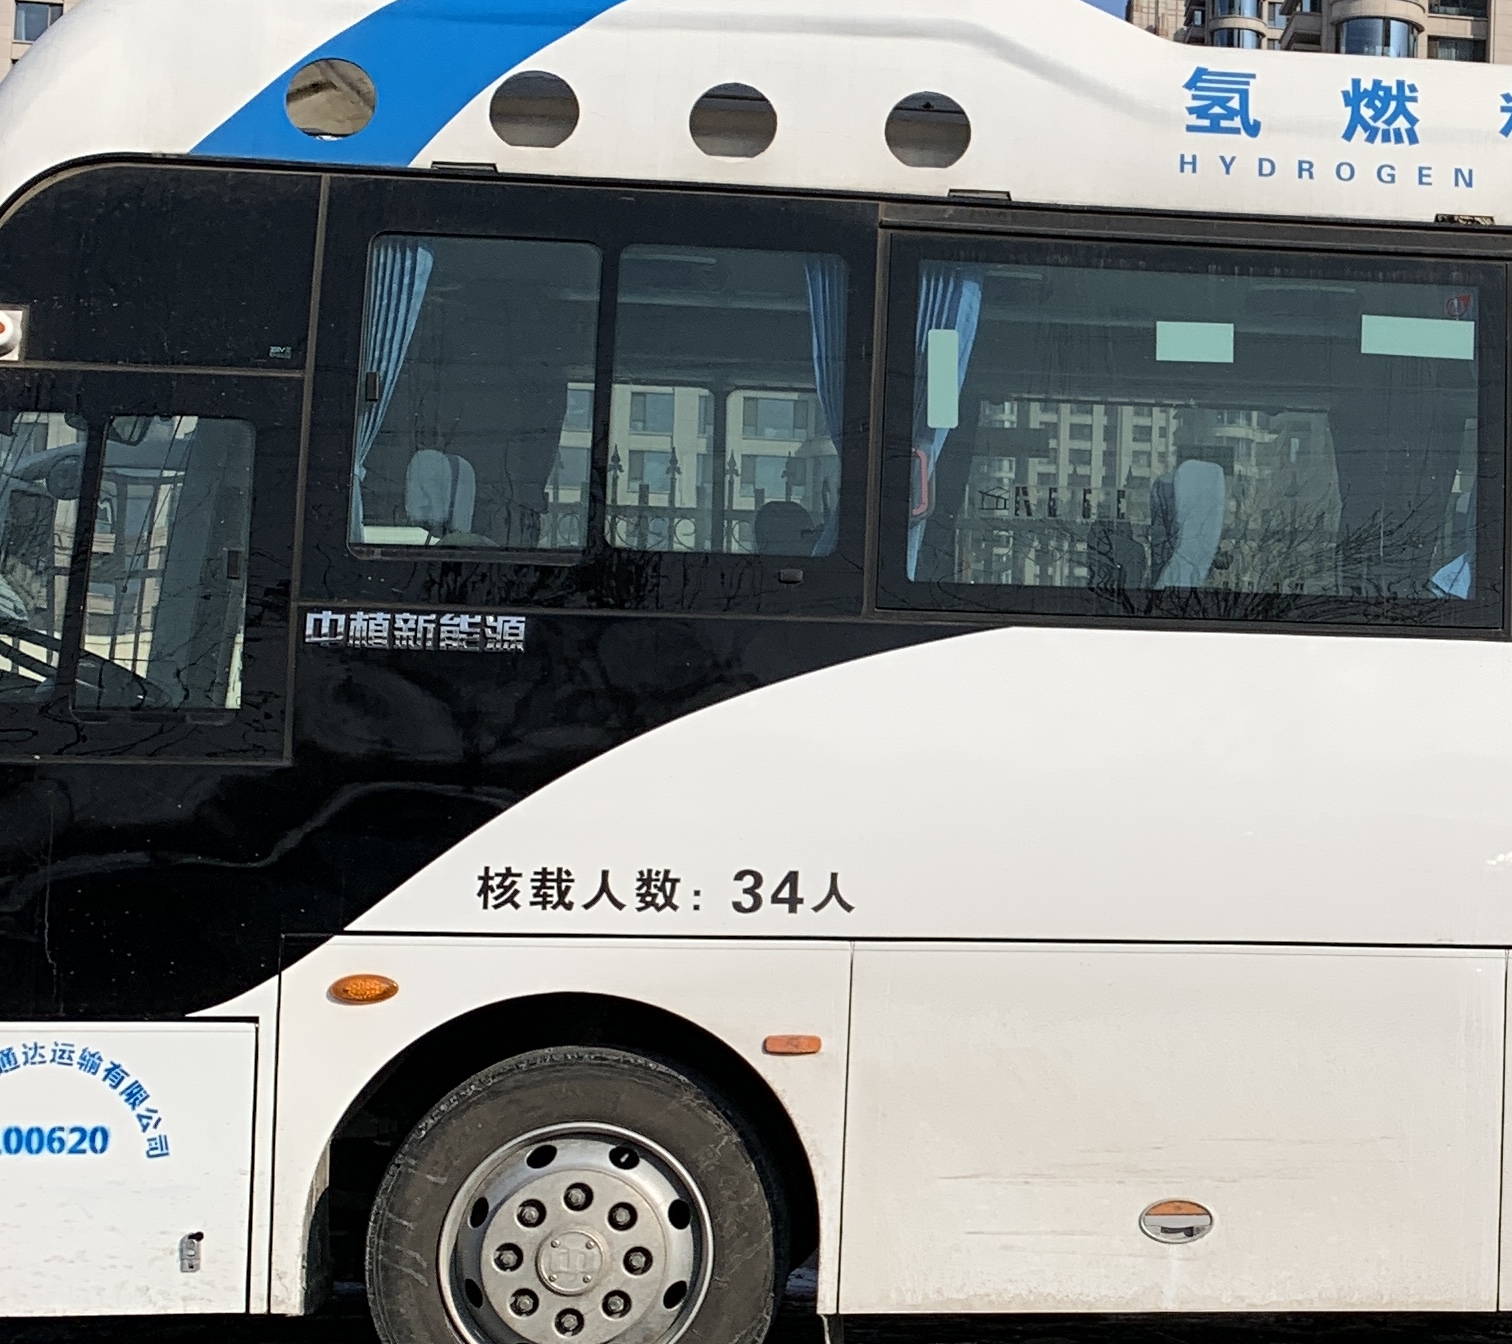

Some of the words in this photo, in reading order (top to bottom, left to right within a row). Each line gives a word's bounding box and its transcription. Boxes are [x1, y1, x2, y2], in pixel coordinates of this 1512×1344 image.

[1180, 154, 1476, 189] HYDROGEN
[304, 610, 526, 652] 中植新能源
[0, 1125, 110, 1155] 00620
